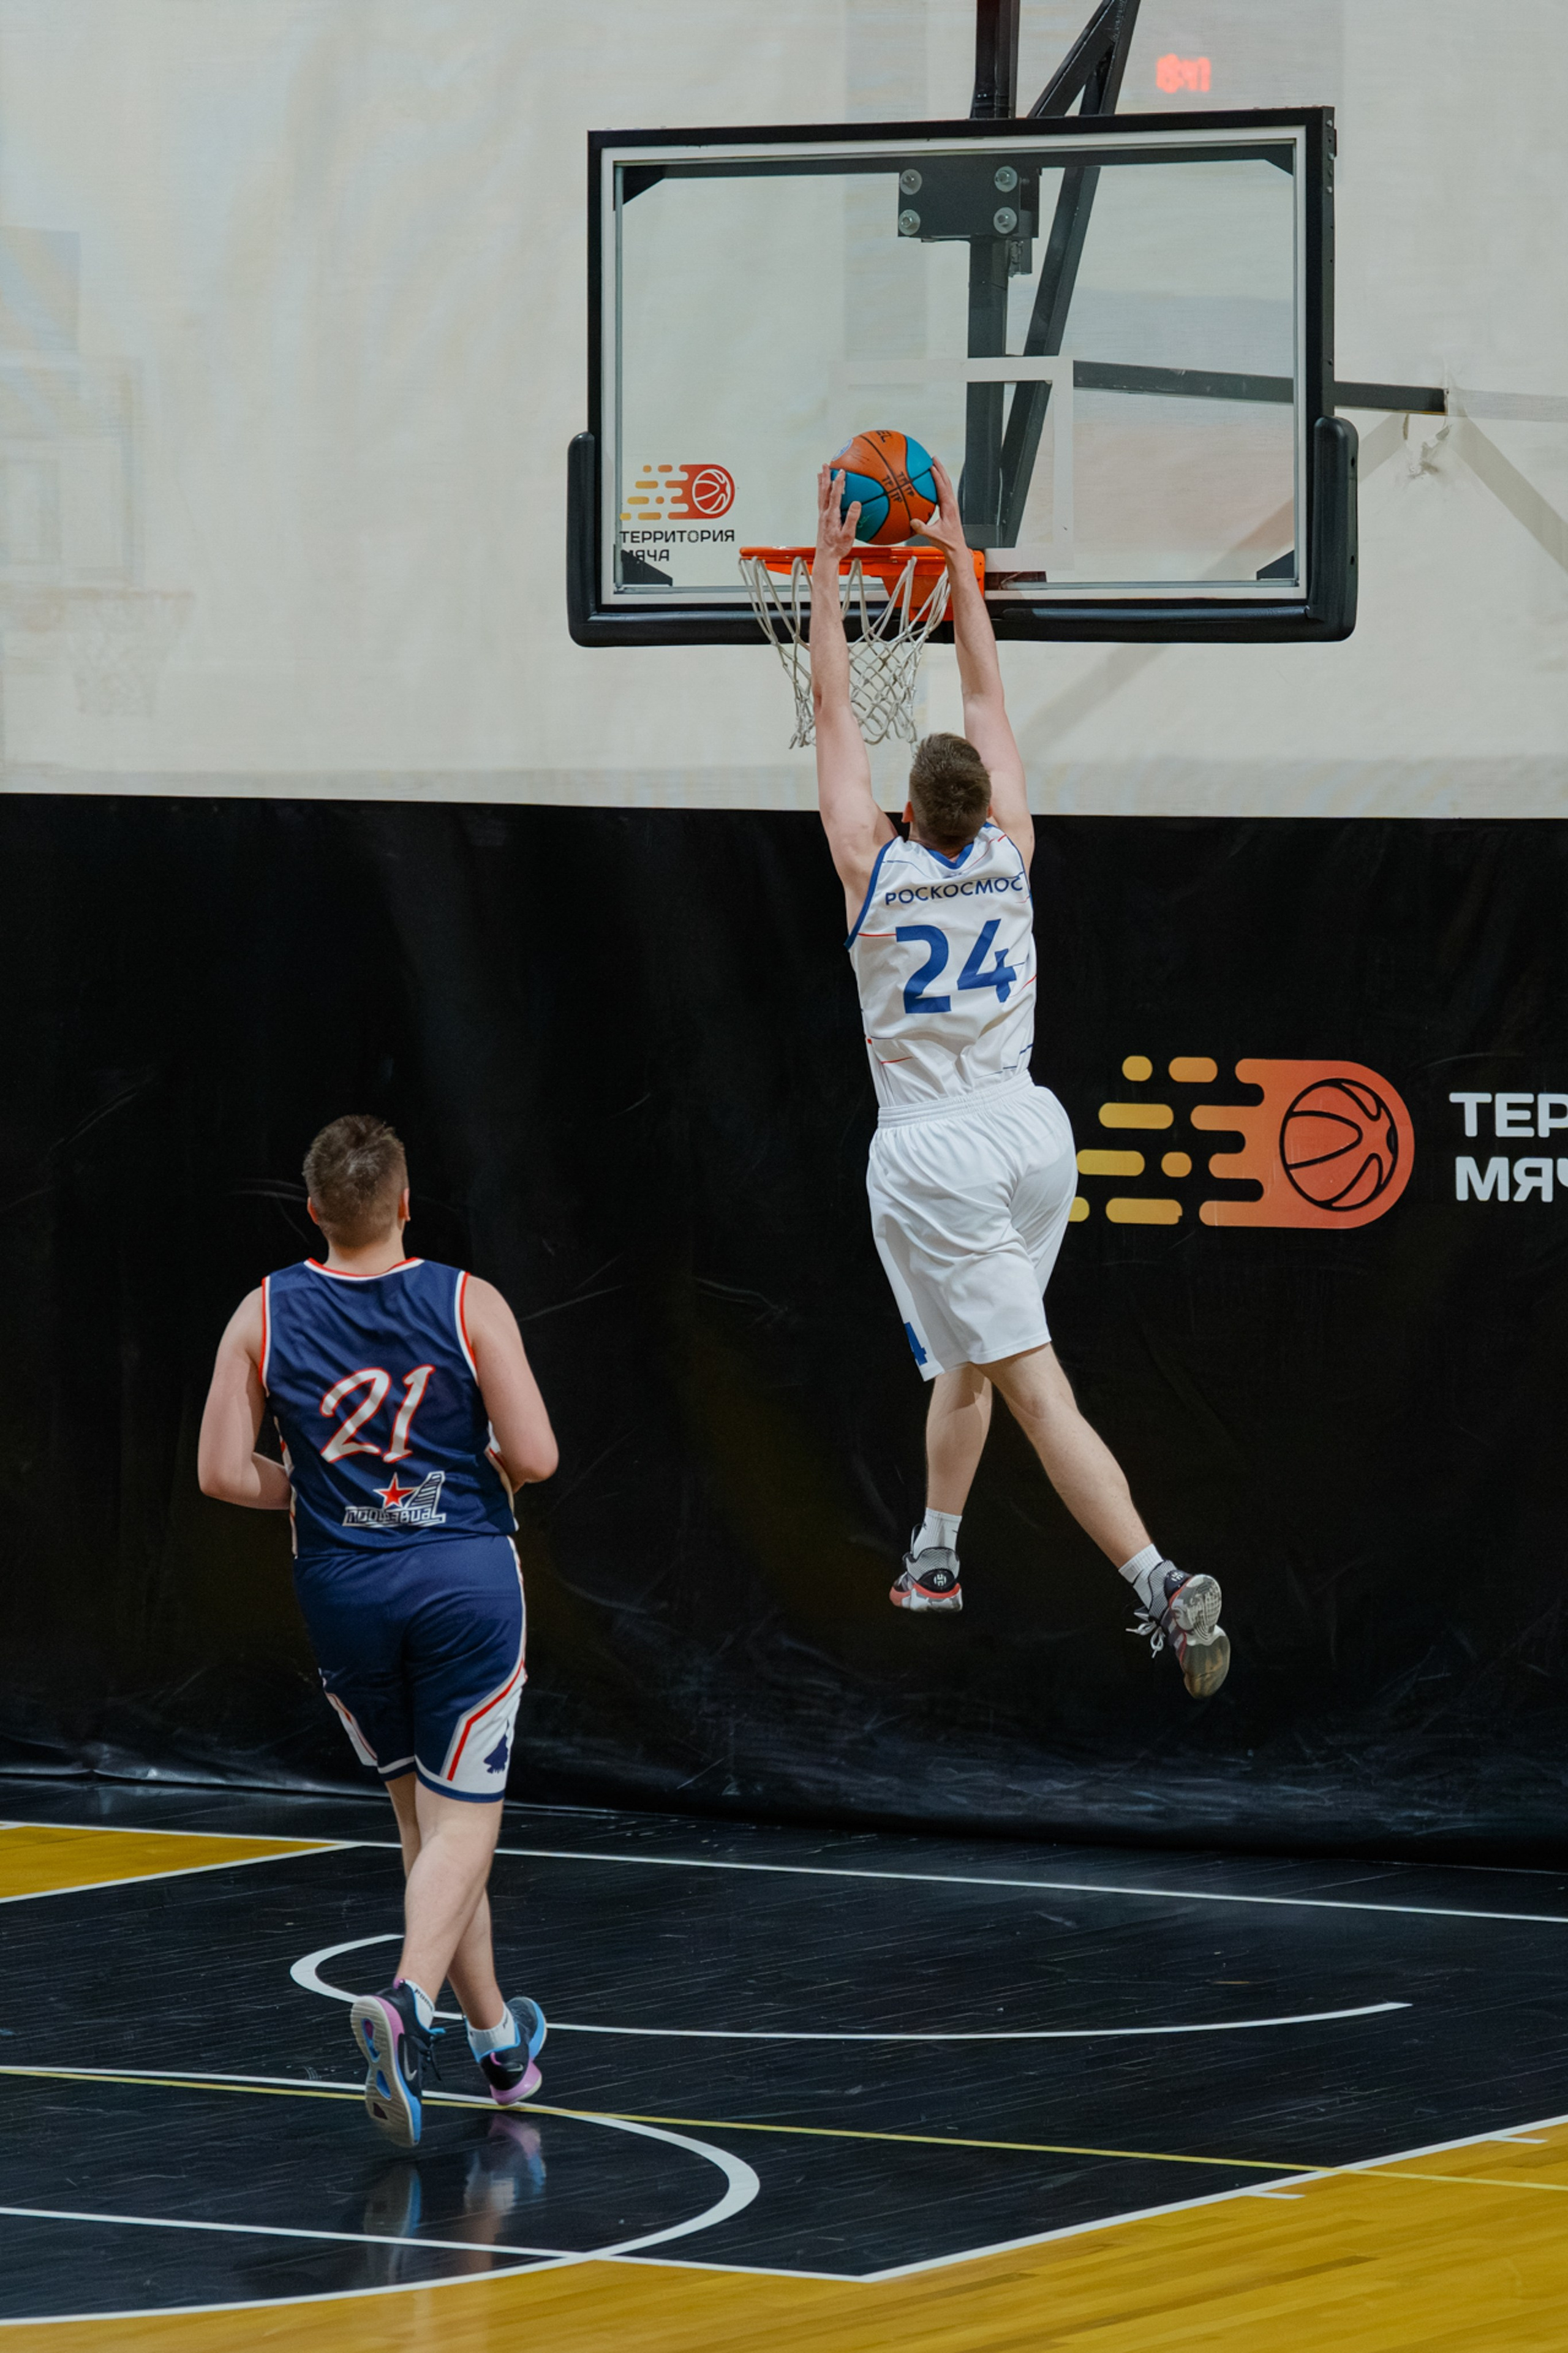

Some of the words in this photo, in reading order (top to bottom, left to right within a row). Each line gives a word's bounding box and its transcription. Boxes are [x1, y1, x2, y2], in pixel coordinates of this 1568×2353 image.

[619, 530, 735, 543] ТЕРРИТОРИЯ
[622, 549, 669, 562] ЯЧА
[884, 877, 1023, 905] РОСКОСМОС
[895, 918, 1017, 1014] 24
[1449, 1092, 1568, 1138] ТЕР
[319, 1364, 436, 1463] 21
